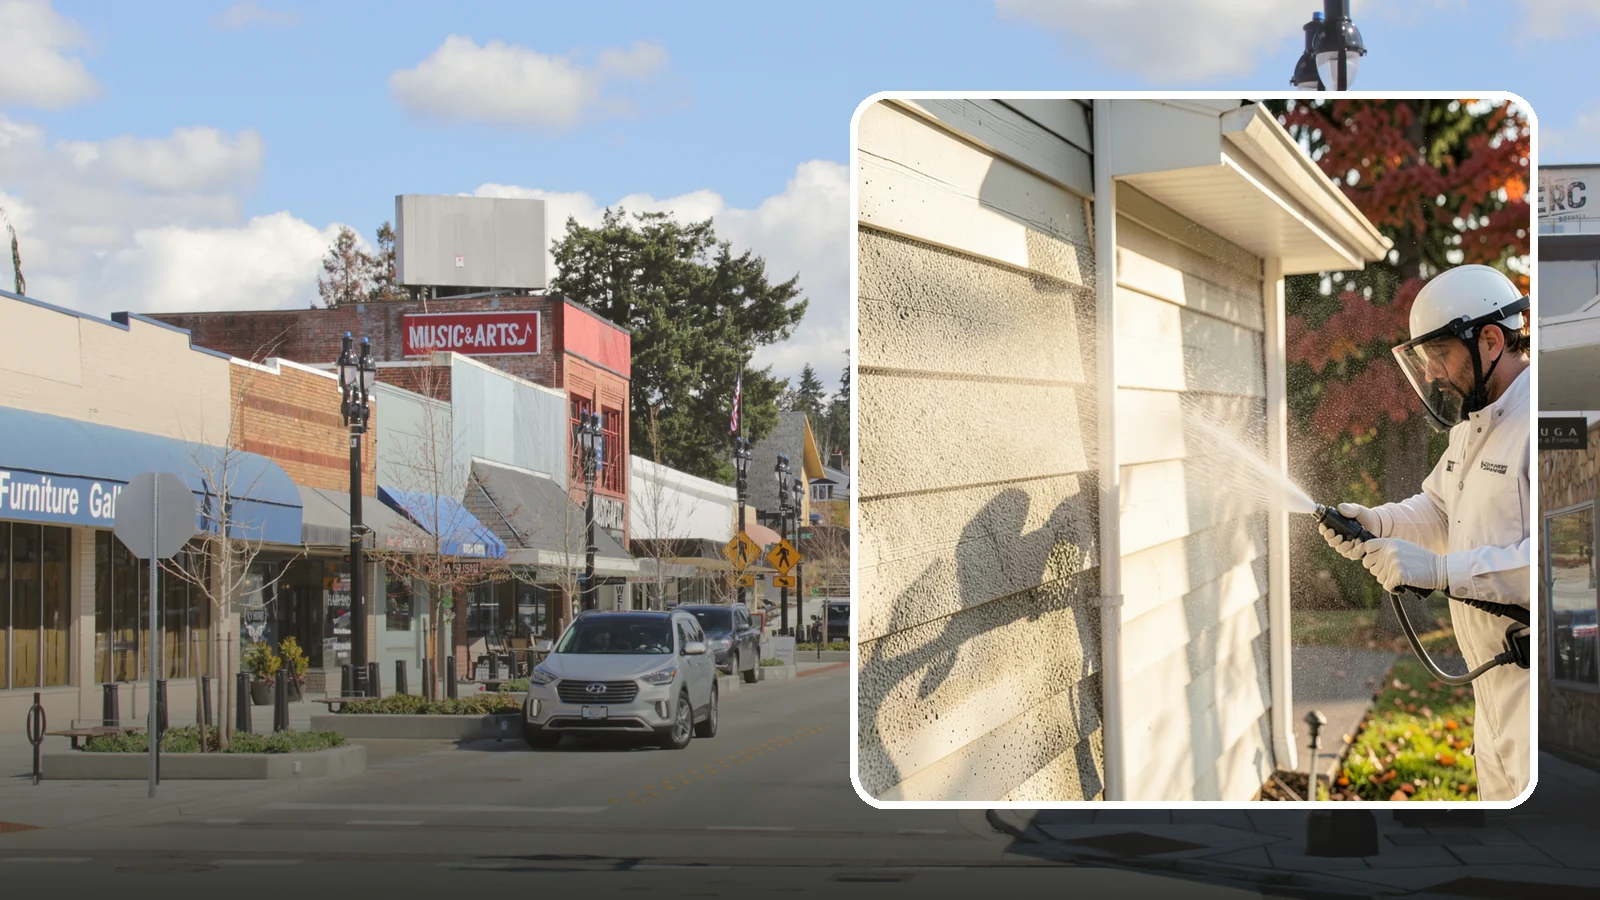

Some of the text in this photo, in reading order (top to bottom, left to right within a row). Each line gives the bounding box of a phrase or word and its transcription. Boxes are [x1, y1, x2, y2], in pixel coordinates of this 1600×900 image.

[409, 323, 519, 348] MUSIC&ARTS
[1540, 427, 1577, 436] UGA
[0, 471, 121, 518] Furniture Gal
[453, 563, 479, 574] SUSHI
